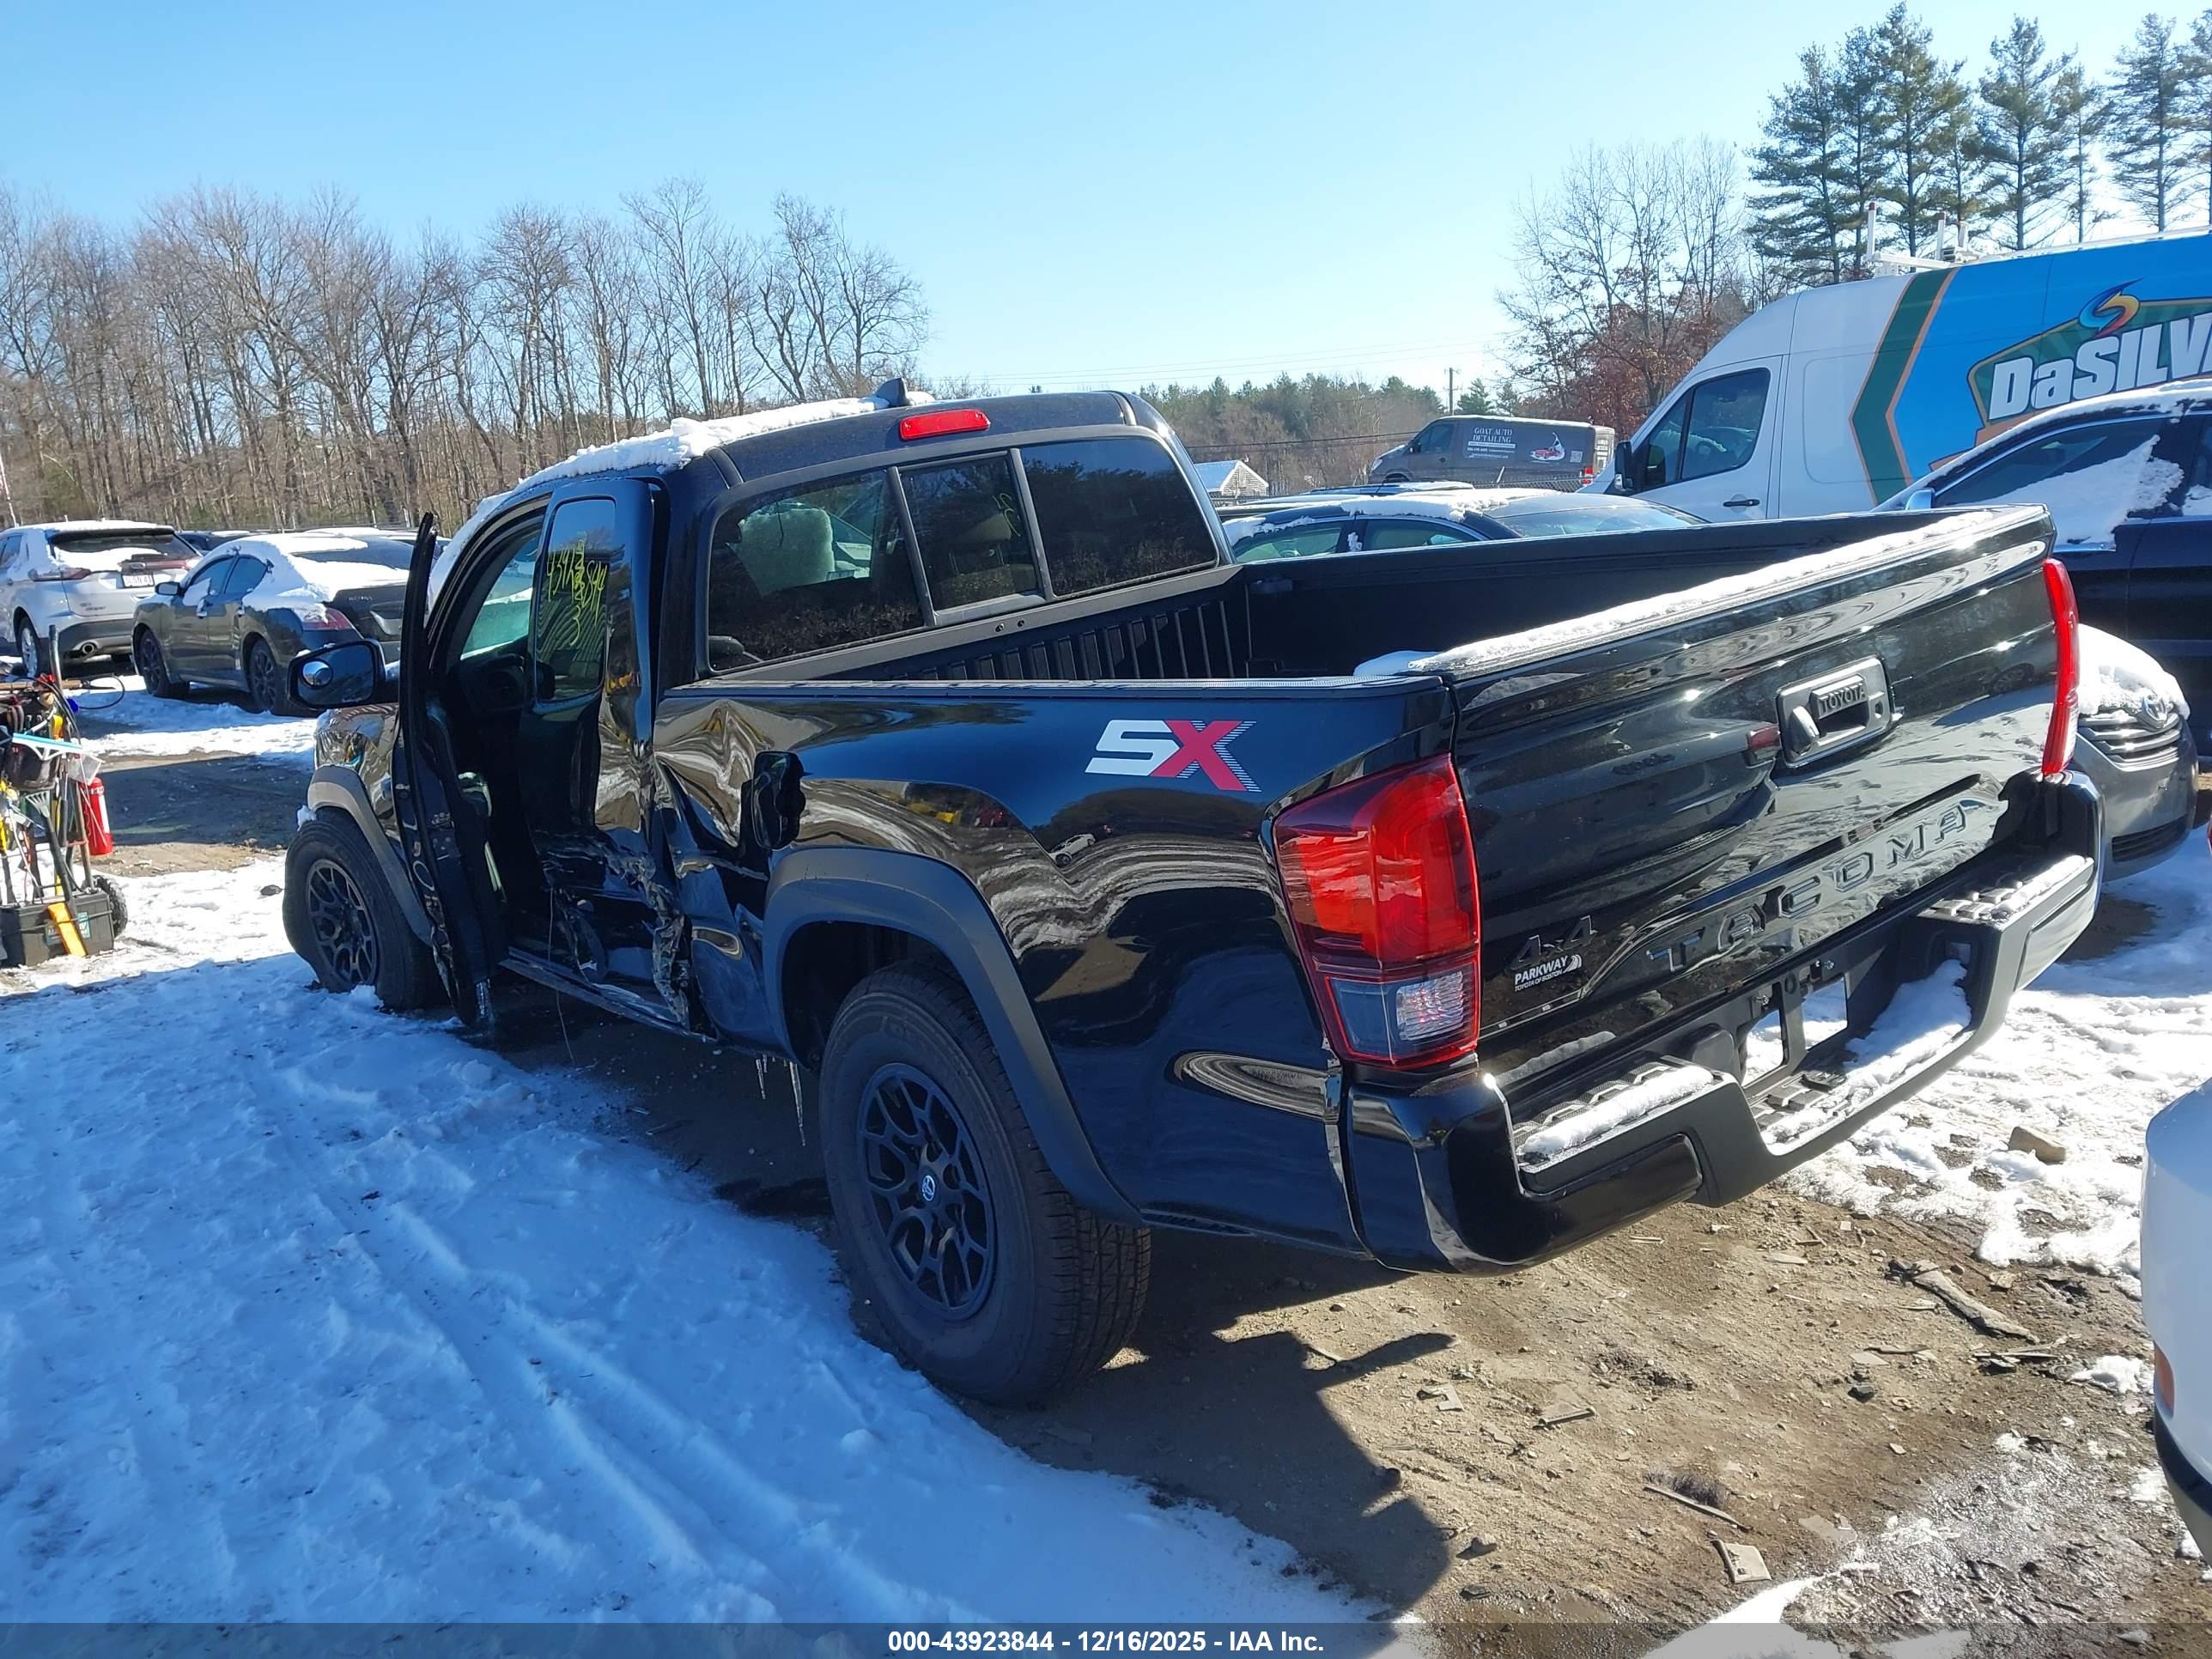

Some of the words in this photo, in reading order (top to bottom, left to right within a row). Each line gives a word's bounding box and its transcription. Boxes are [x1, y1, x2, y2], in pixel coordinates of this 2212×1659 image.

[1989, 312, 2212, 420] DaSILV
[1473, 434, 1511, 443] DETAILING
[1474, 427, 1492, 435] GOAT
[1819, 684, 1867, 714] TOYOTA
[1646, 802, 1968, 971] TACOMA
[1510, 914, 1598, 971] 4x4
[1514, 955, 1568, 985] PARKWAY
[1514, 981, 1534, 993] TOYOTA
[1541, 969, 1563, 982] BOSTON
